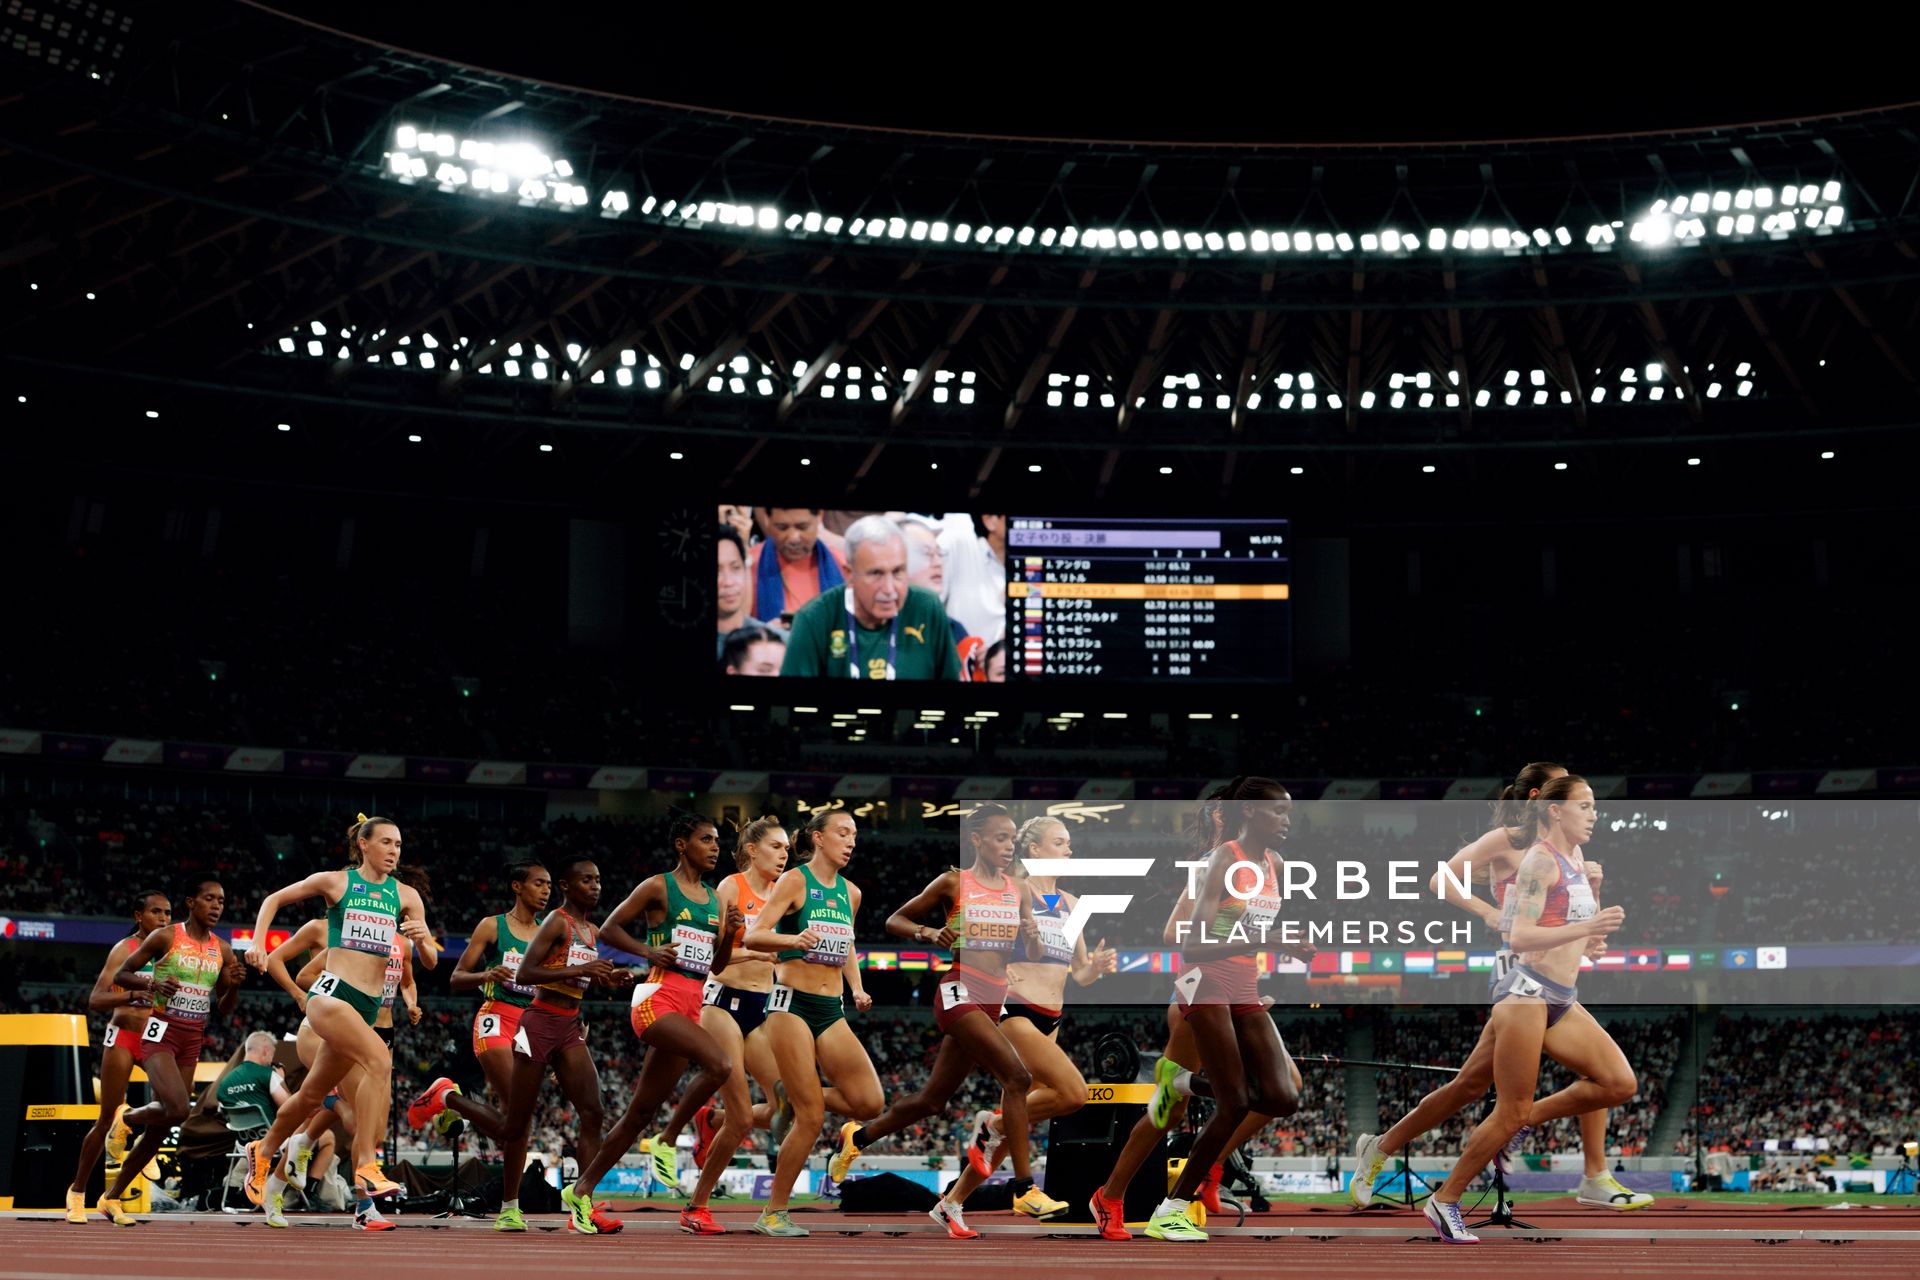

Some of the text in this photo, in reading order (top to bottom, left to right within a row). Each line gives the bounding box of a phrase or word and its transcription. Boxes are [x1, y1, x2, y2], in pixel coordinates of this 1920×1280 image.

[345, 912, 396, 928] HONDA
[350, 925, 388, 942] HALL
[676, 929, 713, 945] HOND
[811, 938, 849, 954] DAVIE
[178, 954, 219, 973] KENYA
[147, 1021, 160, 1038] 8
[483, 1017, 495, 1034] 9
[227, 1083, 257, 1095] SONY
[31, 1108, 56, 1118] SEIKO
